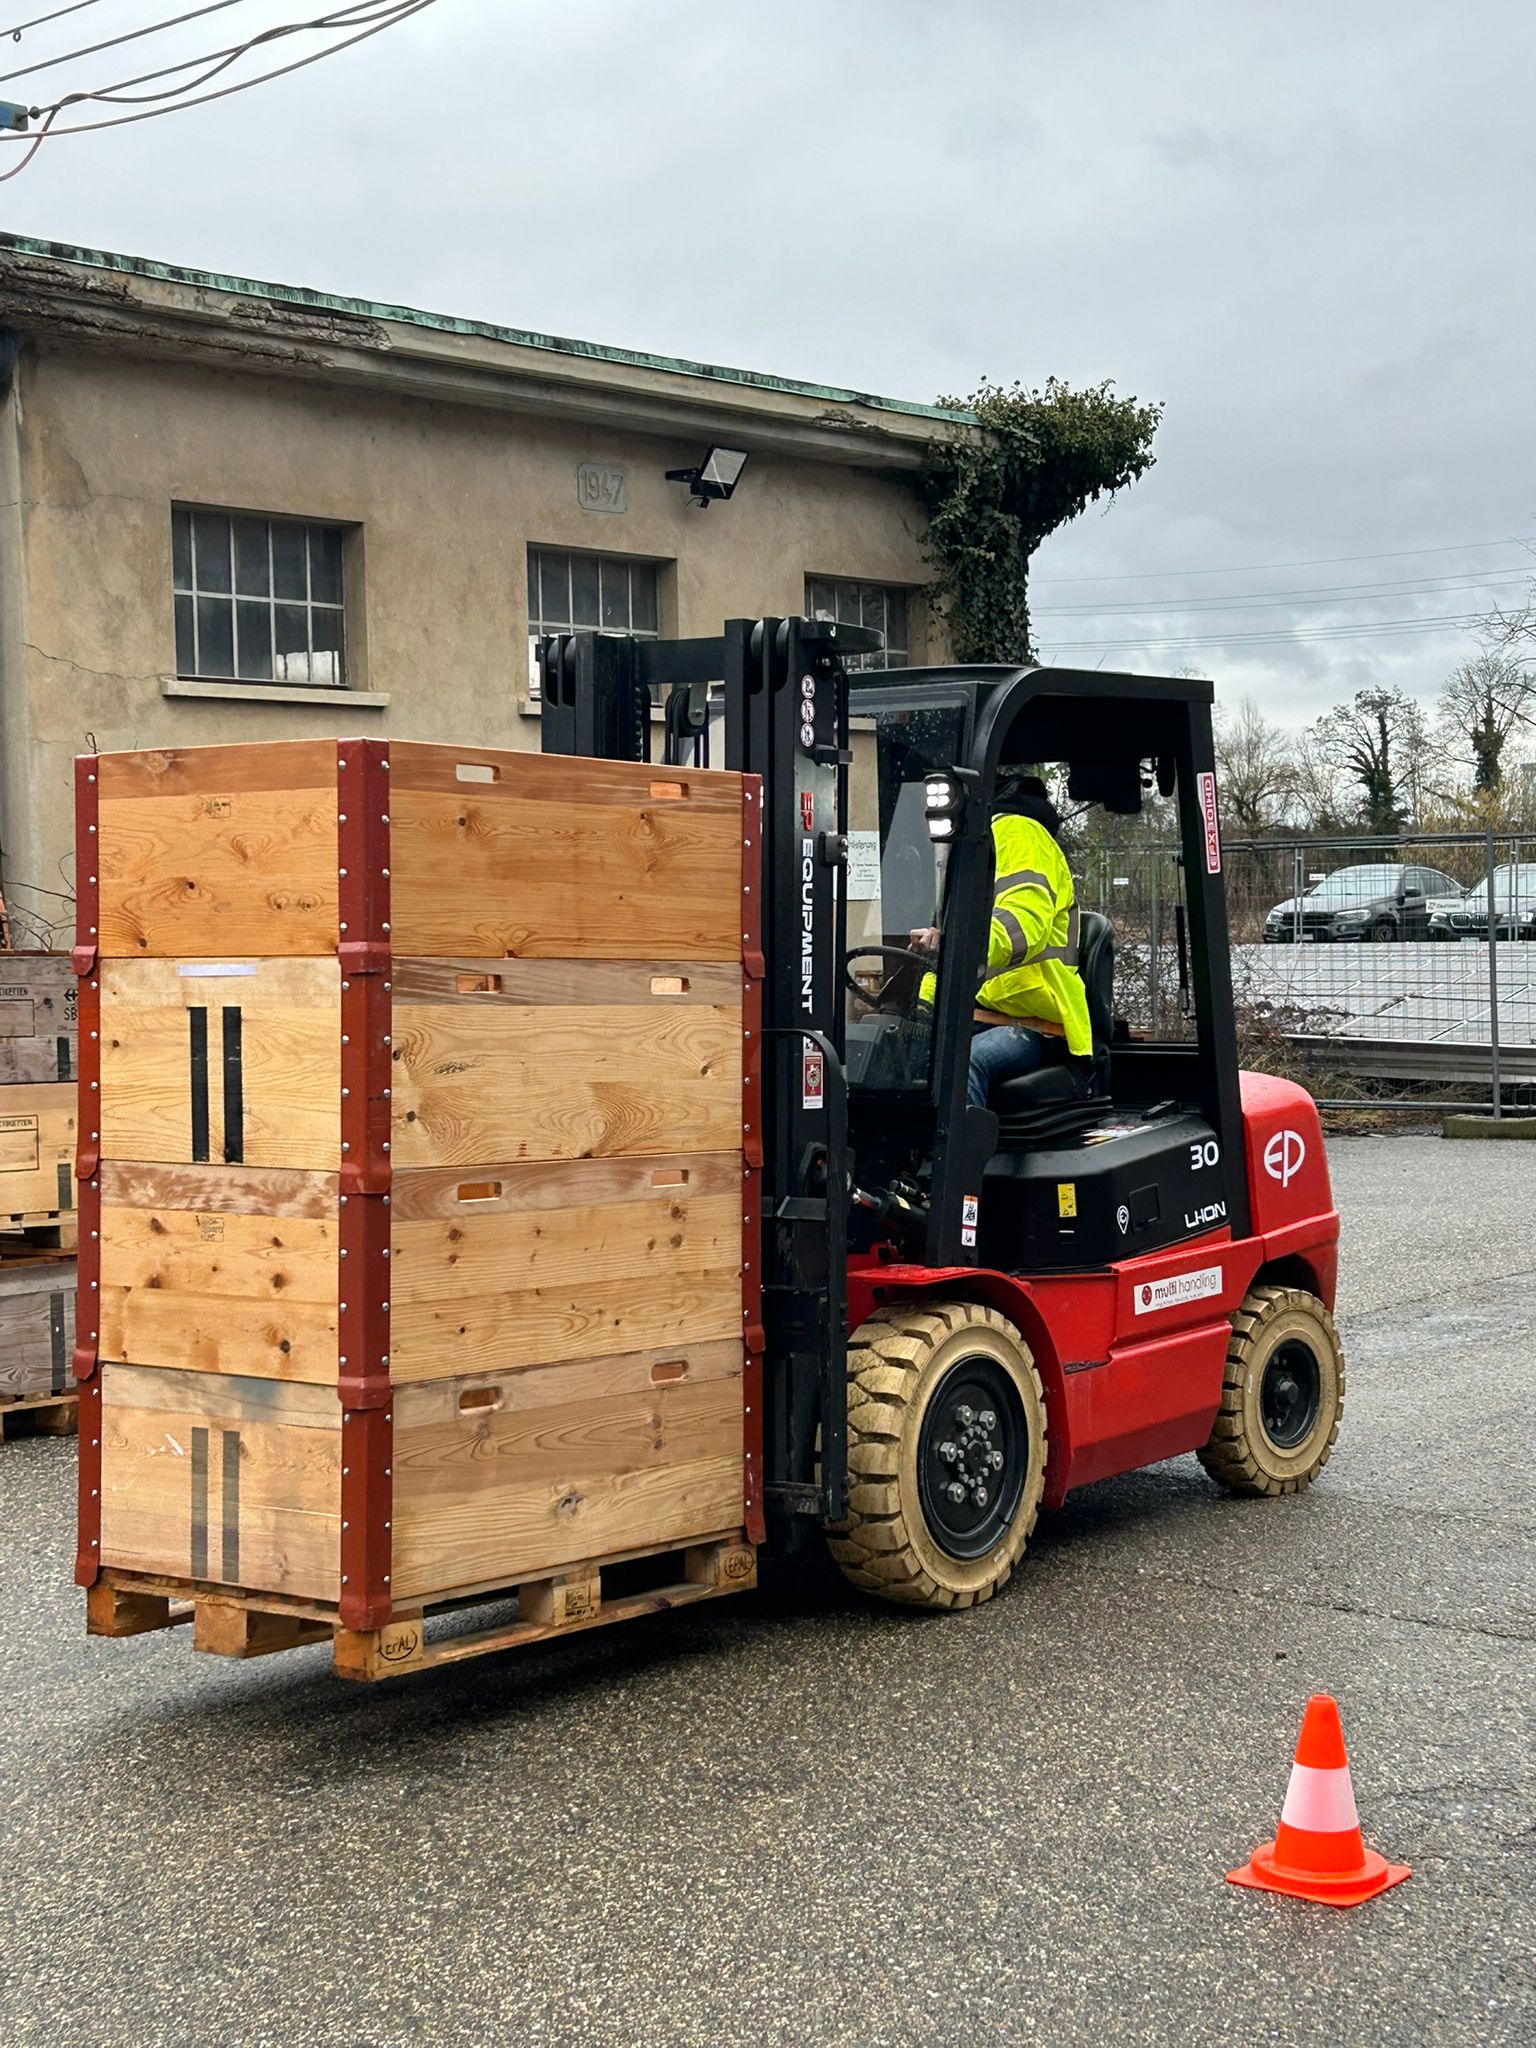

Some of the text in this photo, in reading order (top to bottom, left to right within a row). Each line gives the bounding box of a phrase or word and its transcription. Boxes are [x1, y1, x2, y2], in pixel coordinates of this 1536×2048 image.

[583, 470, 623, 506] 1947
[802, 839, 814, 1015] EQUIPMENT
[1190, 1141, 1219, 1170] 30
[1264, 1130, 1305, 1188] EP
[1154, 1280, 1178, 1300] multi
